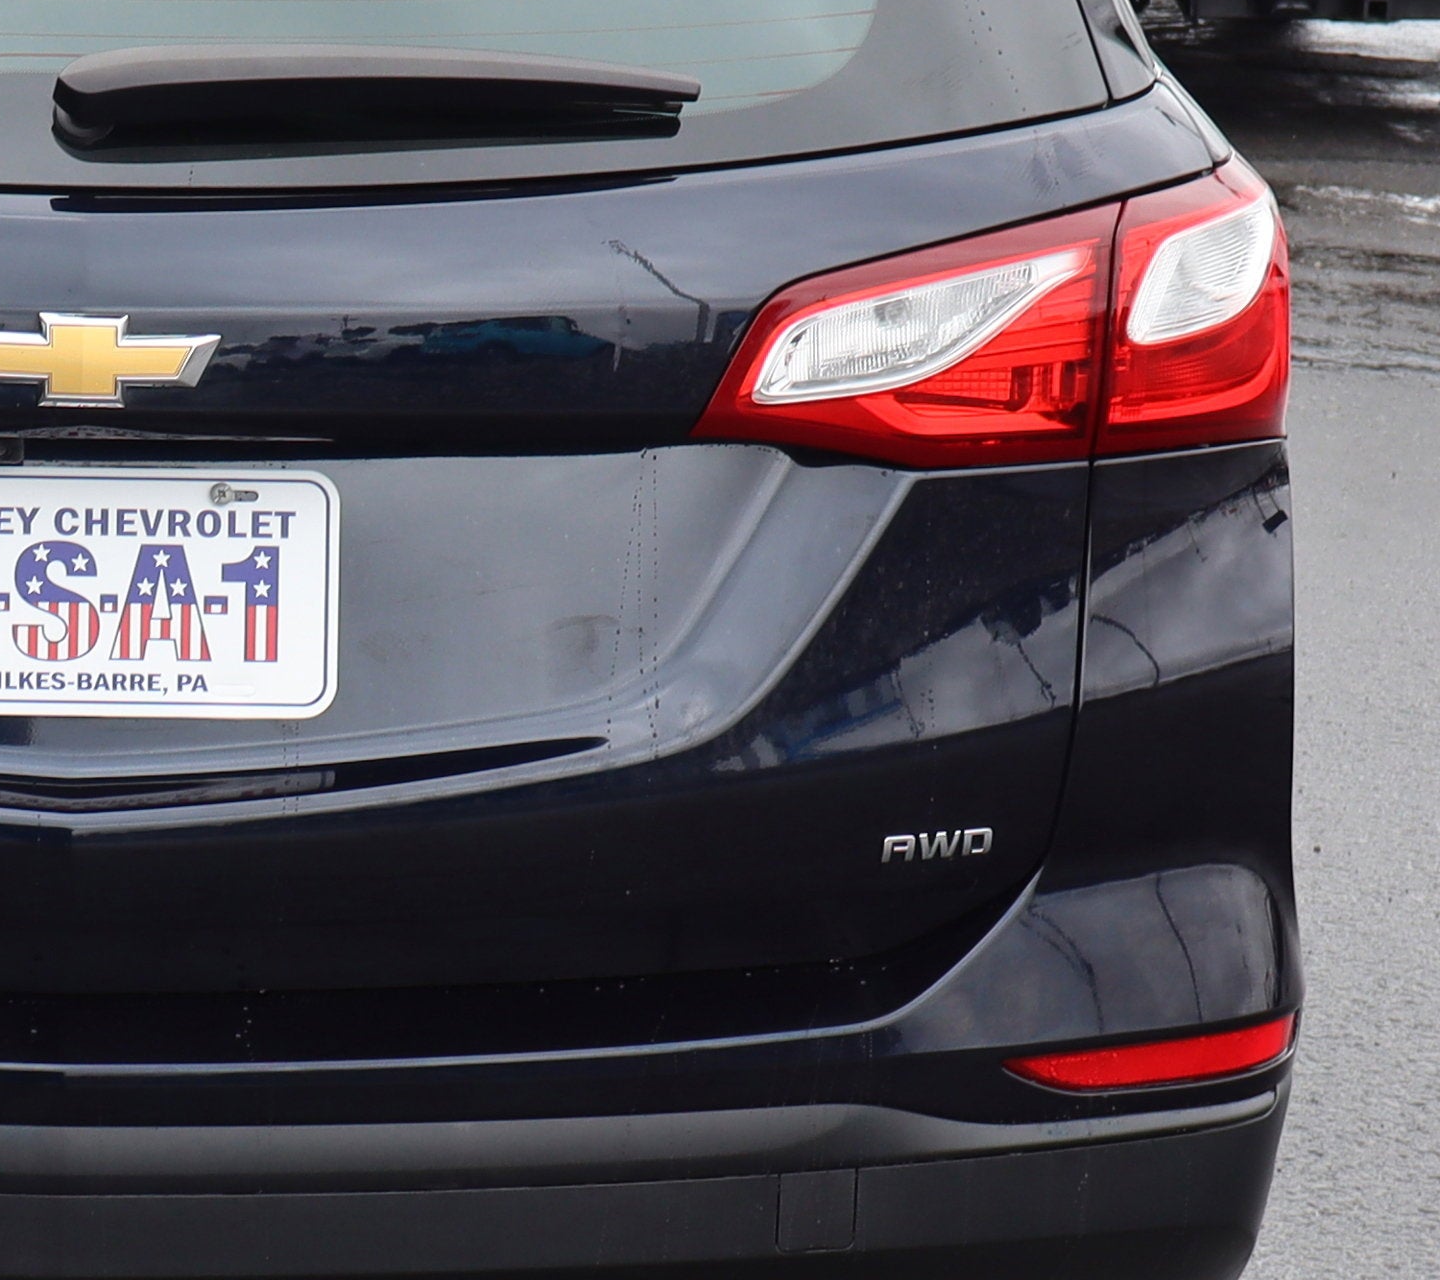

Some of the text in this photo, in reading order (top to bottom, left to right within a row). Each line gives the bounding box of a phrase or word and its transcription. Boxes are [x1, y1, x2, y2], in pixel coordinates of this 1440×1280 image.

[54, 507, 296, 539] CHEVROLET
[177, 674, 208, 692] PA
[881, 826, 994, 864] AWD
